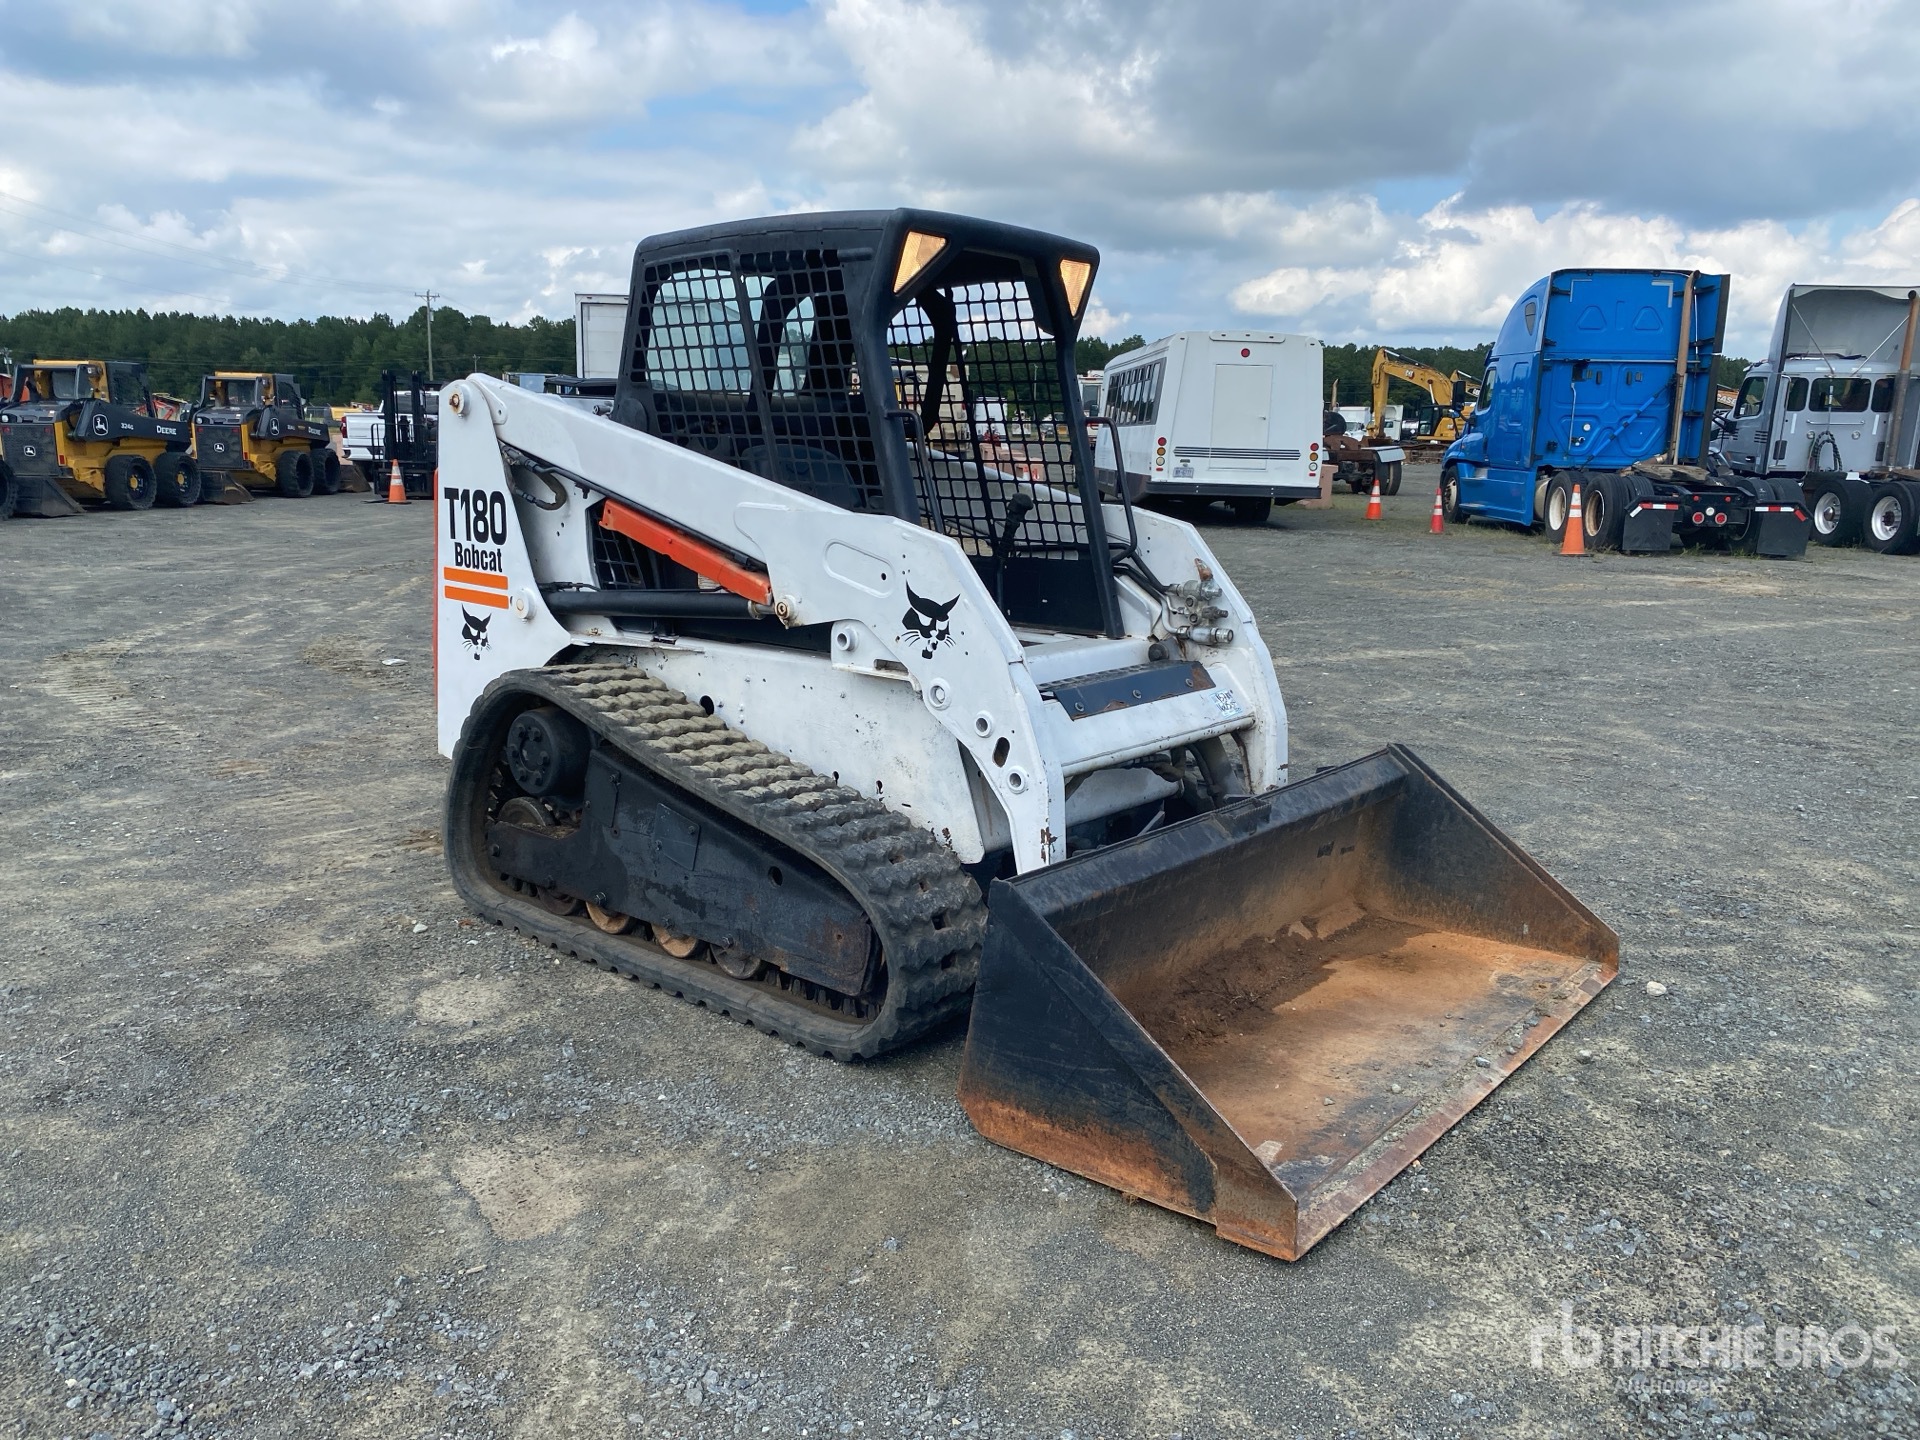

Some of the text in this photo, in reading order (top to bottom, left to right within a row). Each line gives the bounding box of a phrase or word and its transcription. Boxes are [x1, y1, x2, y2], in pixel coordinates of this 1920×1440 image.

[156, 425, 177, 435] DEERE
[444, 487, 507, 546] T180
[454, 541, 503, 573] Bobcat
